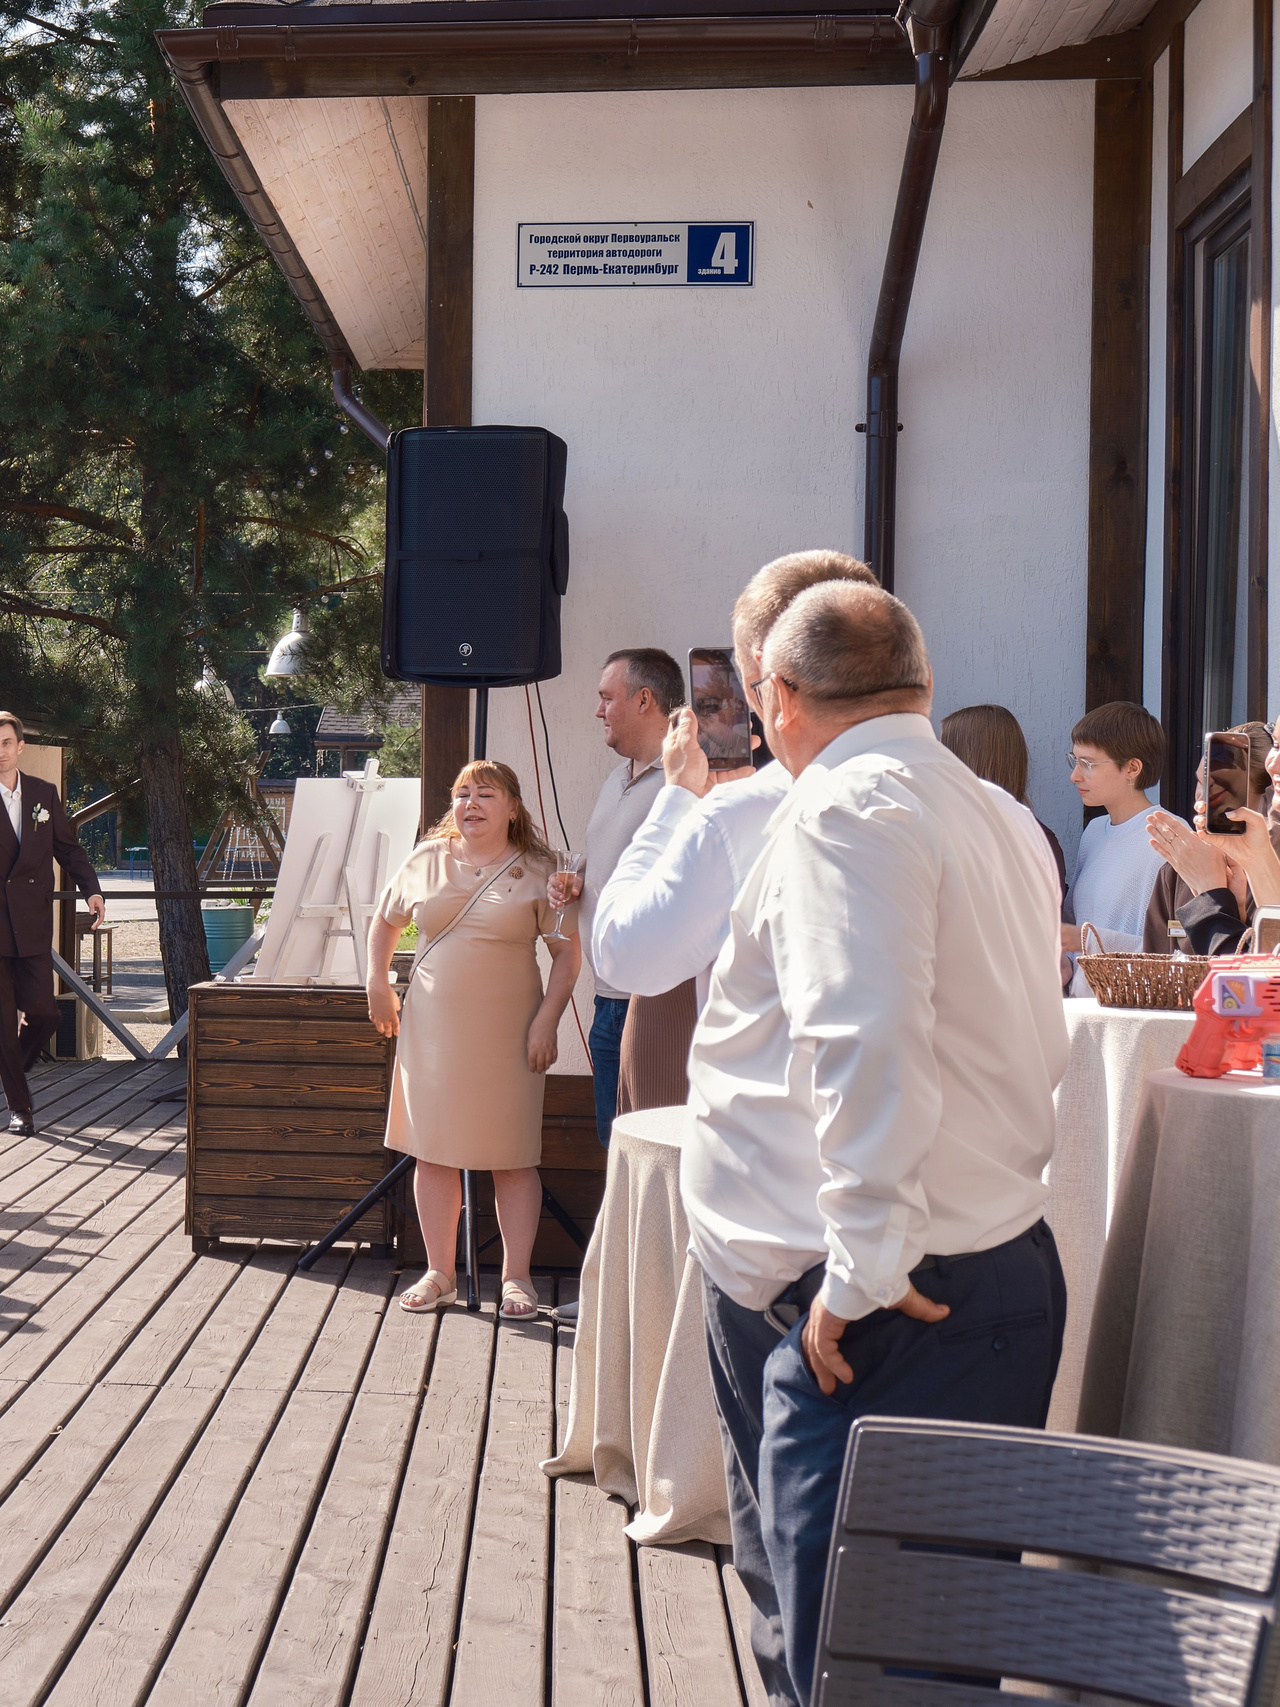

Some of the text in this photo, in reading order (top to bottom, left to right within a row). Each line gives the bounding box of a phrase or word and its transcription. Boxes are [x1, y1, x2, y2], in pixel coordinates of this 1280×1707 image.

[529, 233, 680, 245] Городской округ Первоуральск
[547, 249, 662, 259] территория автодороги
[711, 232, 738, 274] 4
[529, 262, 679, 275] Р-242 Пермь-Екатеринбург
